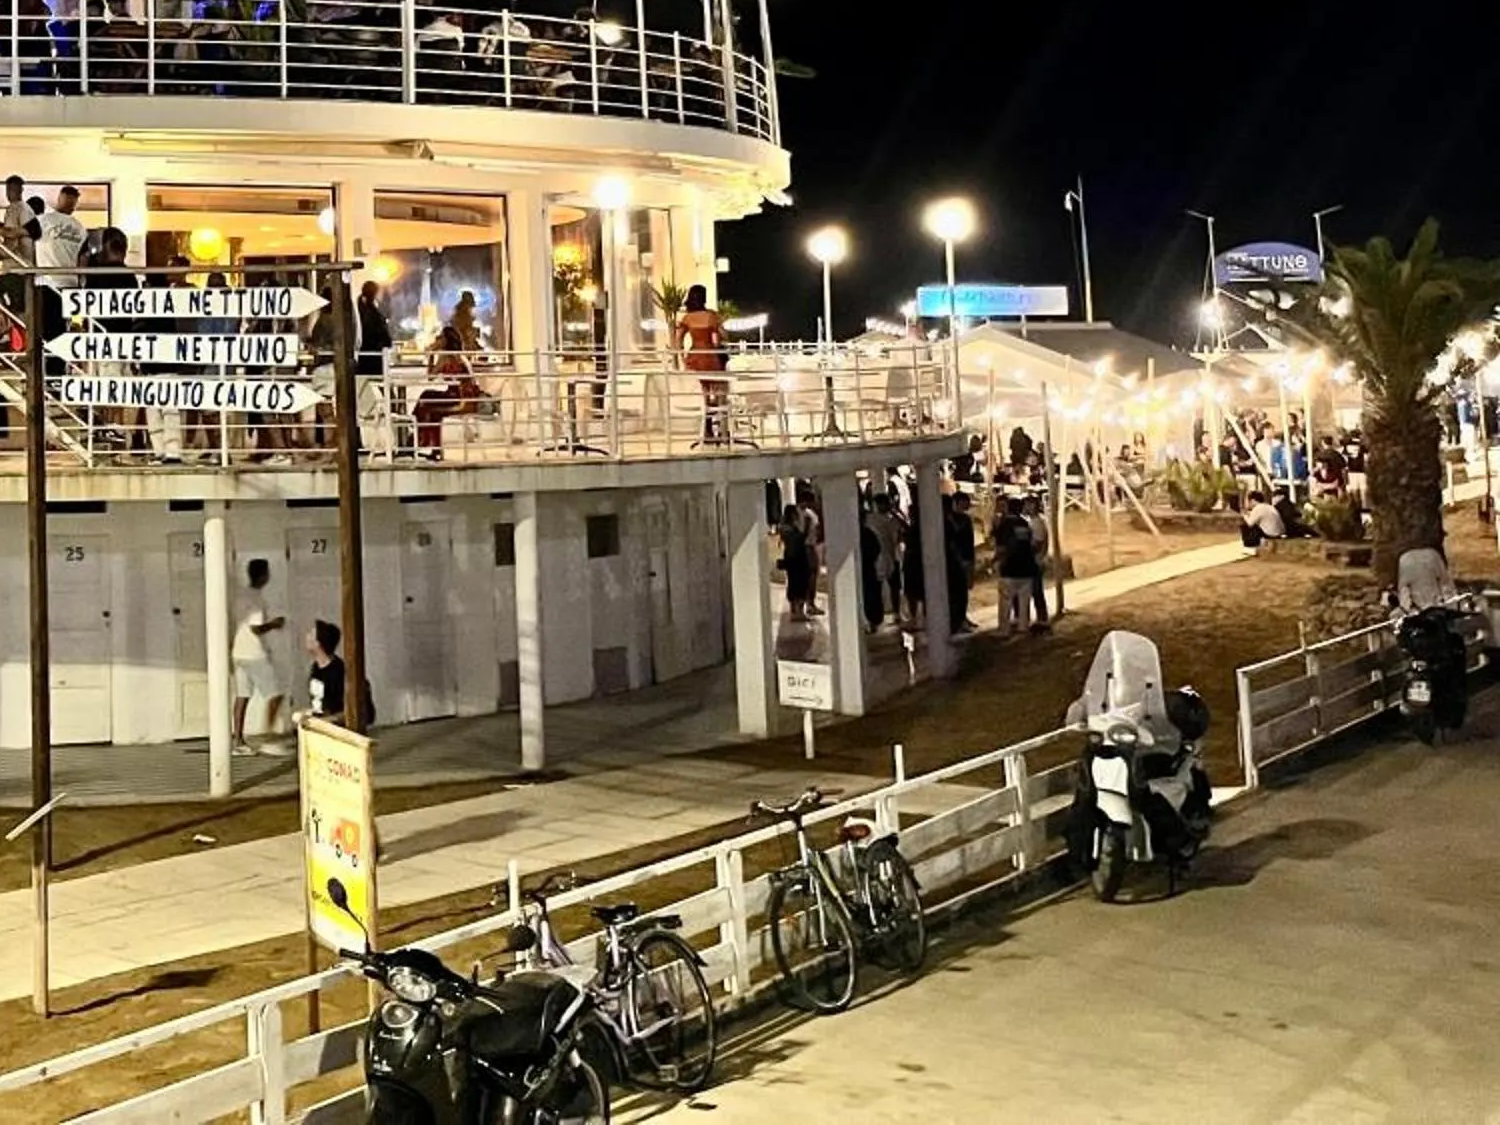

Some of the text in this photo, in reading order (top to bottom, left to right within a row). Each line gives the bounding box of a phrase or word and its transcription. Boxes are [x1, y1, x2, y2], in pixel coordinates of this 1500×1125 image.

[69, 287, 292, 316] SPIAGGIA NETTUNO
[70, 335, 287, 364] CHALET NETTUNO
[64, 378, 296, 411] CHIRINGUITO CAICOS
[65, 546, 85, 562] 25
[311, 538, 327, 554] 27
